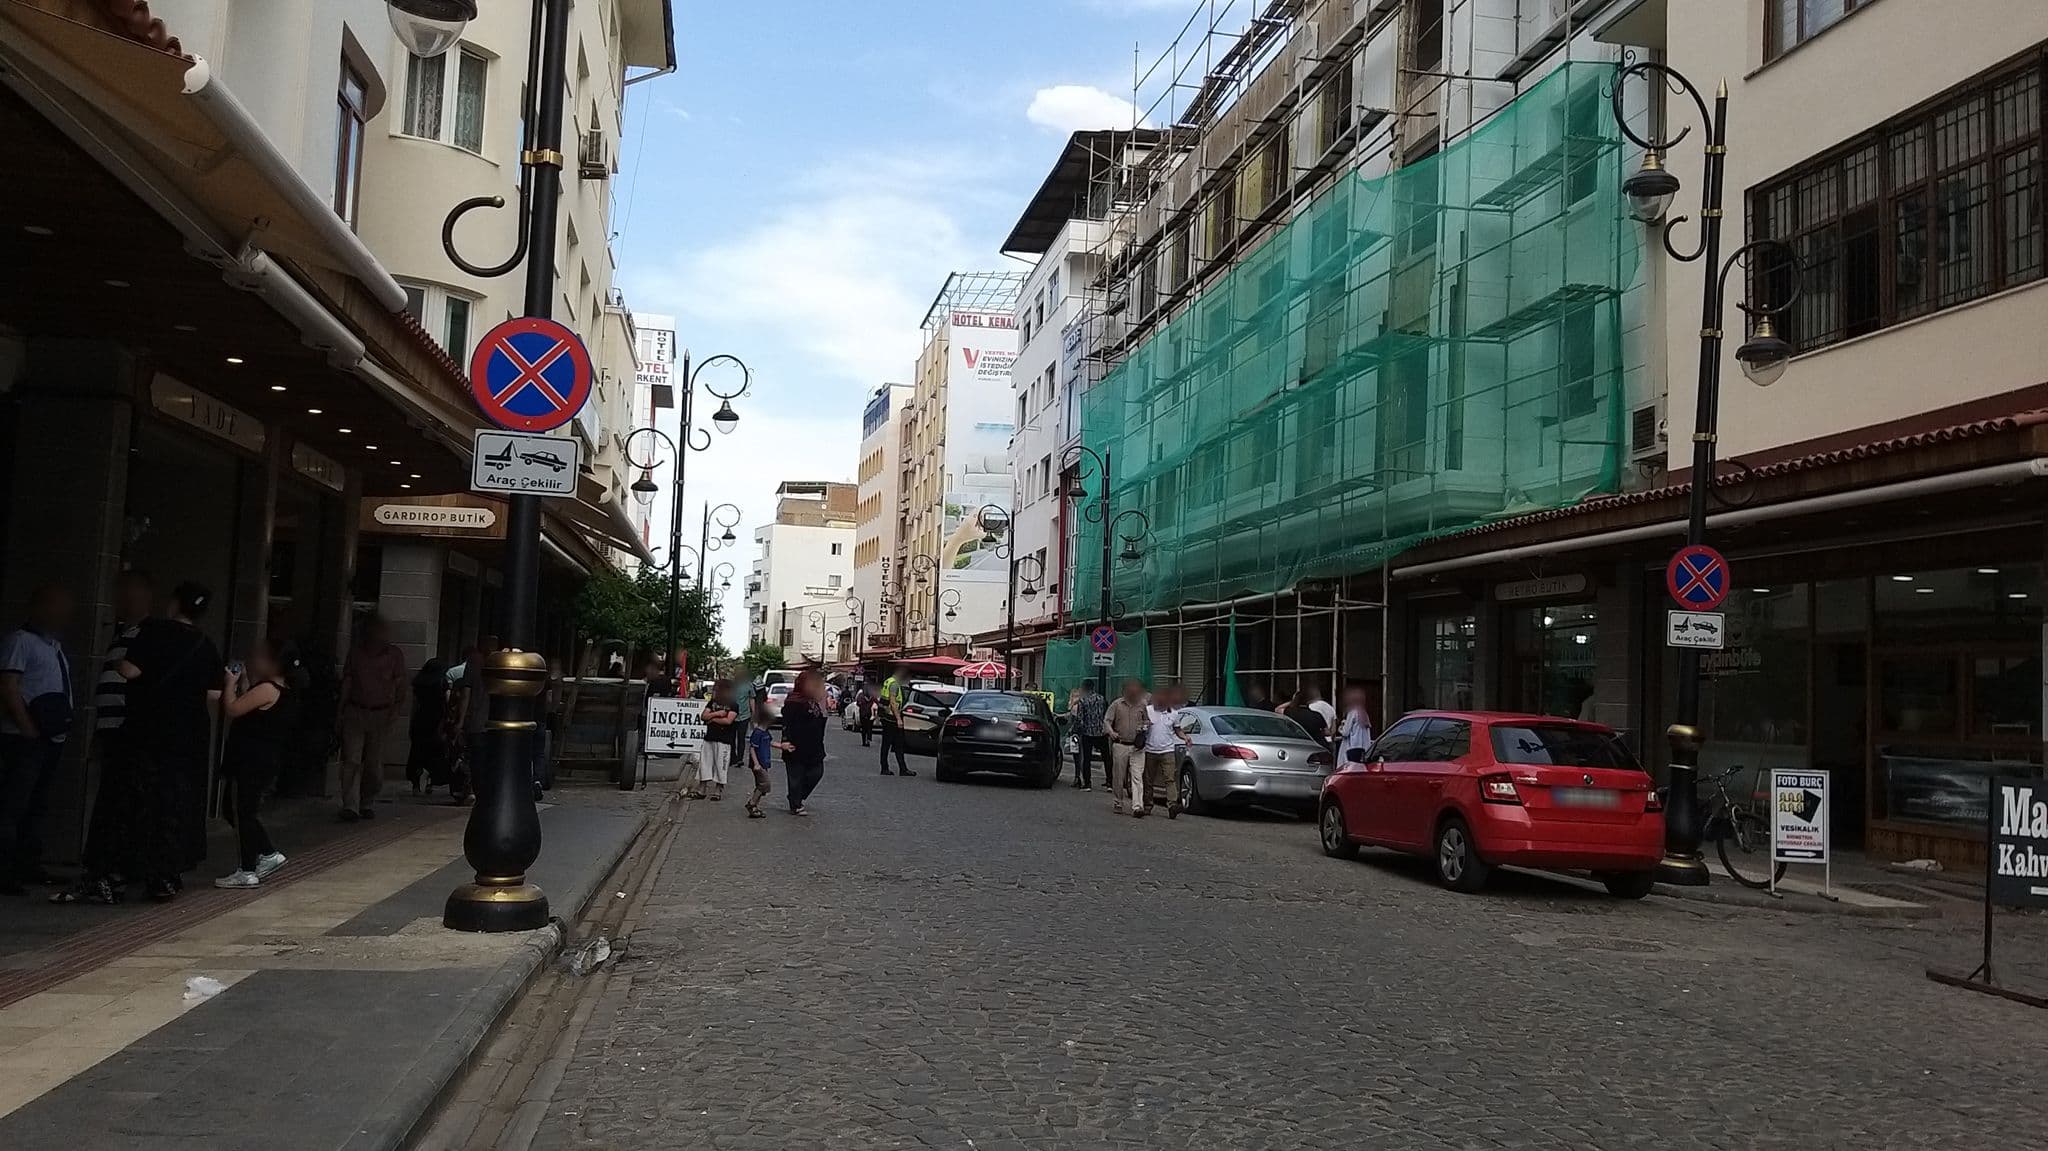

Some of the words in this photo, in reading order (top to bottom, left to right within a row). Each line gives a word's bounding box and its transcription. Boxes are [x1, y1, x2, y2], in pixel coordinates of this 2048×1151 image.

[953, 314, 983, 326] HOTEL
[657, 331, 667, 362] HOTEL
[486, 474, 517, 488] Araç
[521, 476, 563, 489] Çekilir
[383, 510, 447, 523] GARDIROP
[450, 511, 486, 524] BUTİK
[1675, 634, 1691, 642] Araç
[1693, 635, 1717, 643] Çekilir
[652, 707, 706, 726] İNCİRA
[650, 727, 678, 741] Konağı
[681, 728, 687, 739] &
[1777, 776, 1798, 786] FOTO
[1799, 776, 1823, 788] BURÇ
[2000, 785, 2048, 839] Ma
